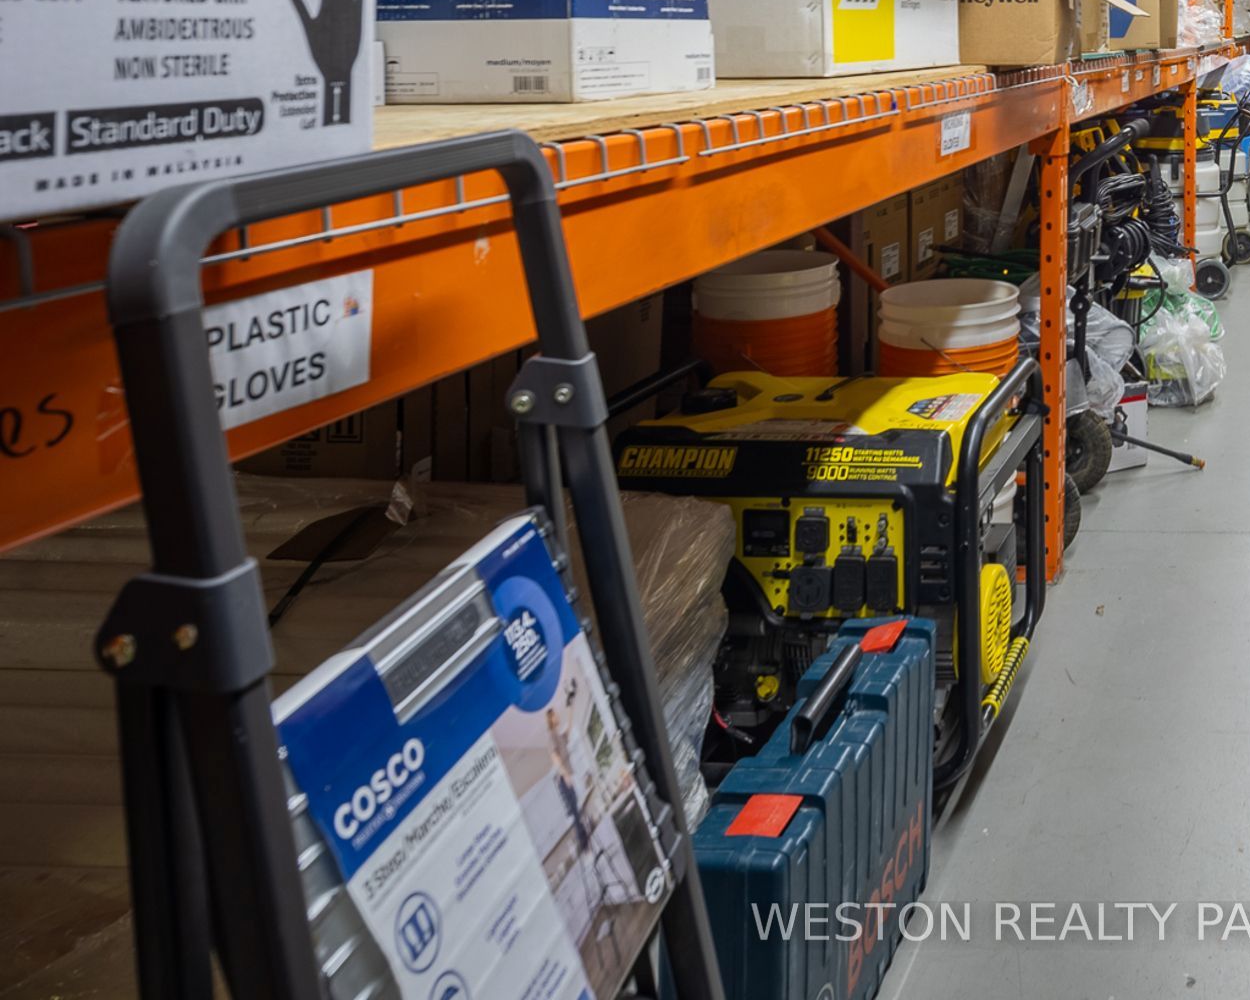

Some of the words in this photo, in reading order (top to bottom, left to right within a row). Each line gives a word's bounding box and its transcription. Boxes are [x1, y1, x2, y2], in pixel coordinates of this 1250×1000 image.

[114, 17, 256, 41] AMBIDEXTROUS
[114, 56, 156, 80] NON
[160, 53, 231, 79] STERILE
[71, 109, 199, 149] Standard
[203, 106, 262, 139] Duty
[35, 173, 100, 192] MADE
[112, 167, 134, 182] IN
[148, 155, 244, 178] MALAYSIA
[206, 299, 331, 354] PLASTIC
[620, 447, 735, 469] CHAMPION
[805, 446, 855, 463] 11250
[884, 449, 904, 457] WATTS
[806, 465, 849, 480] 9000
[333, 737, 425, 840] COSCO
[848, 803, 924, 999] BOSCH
